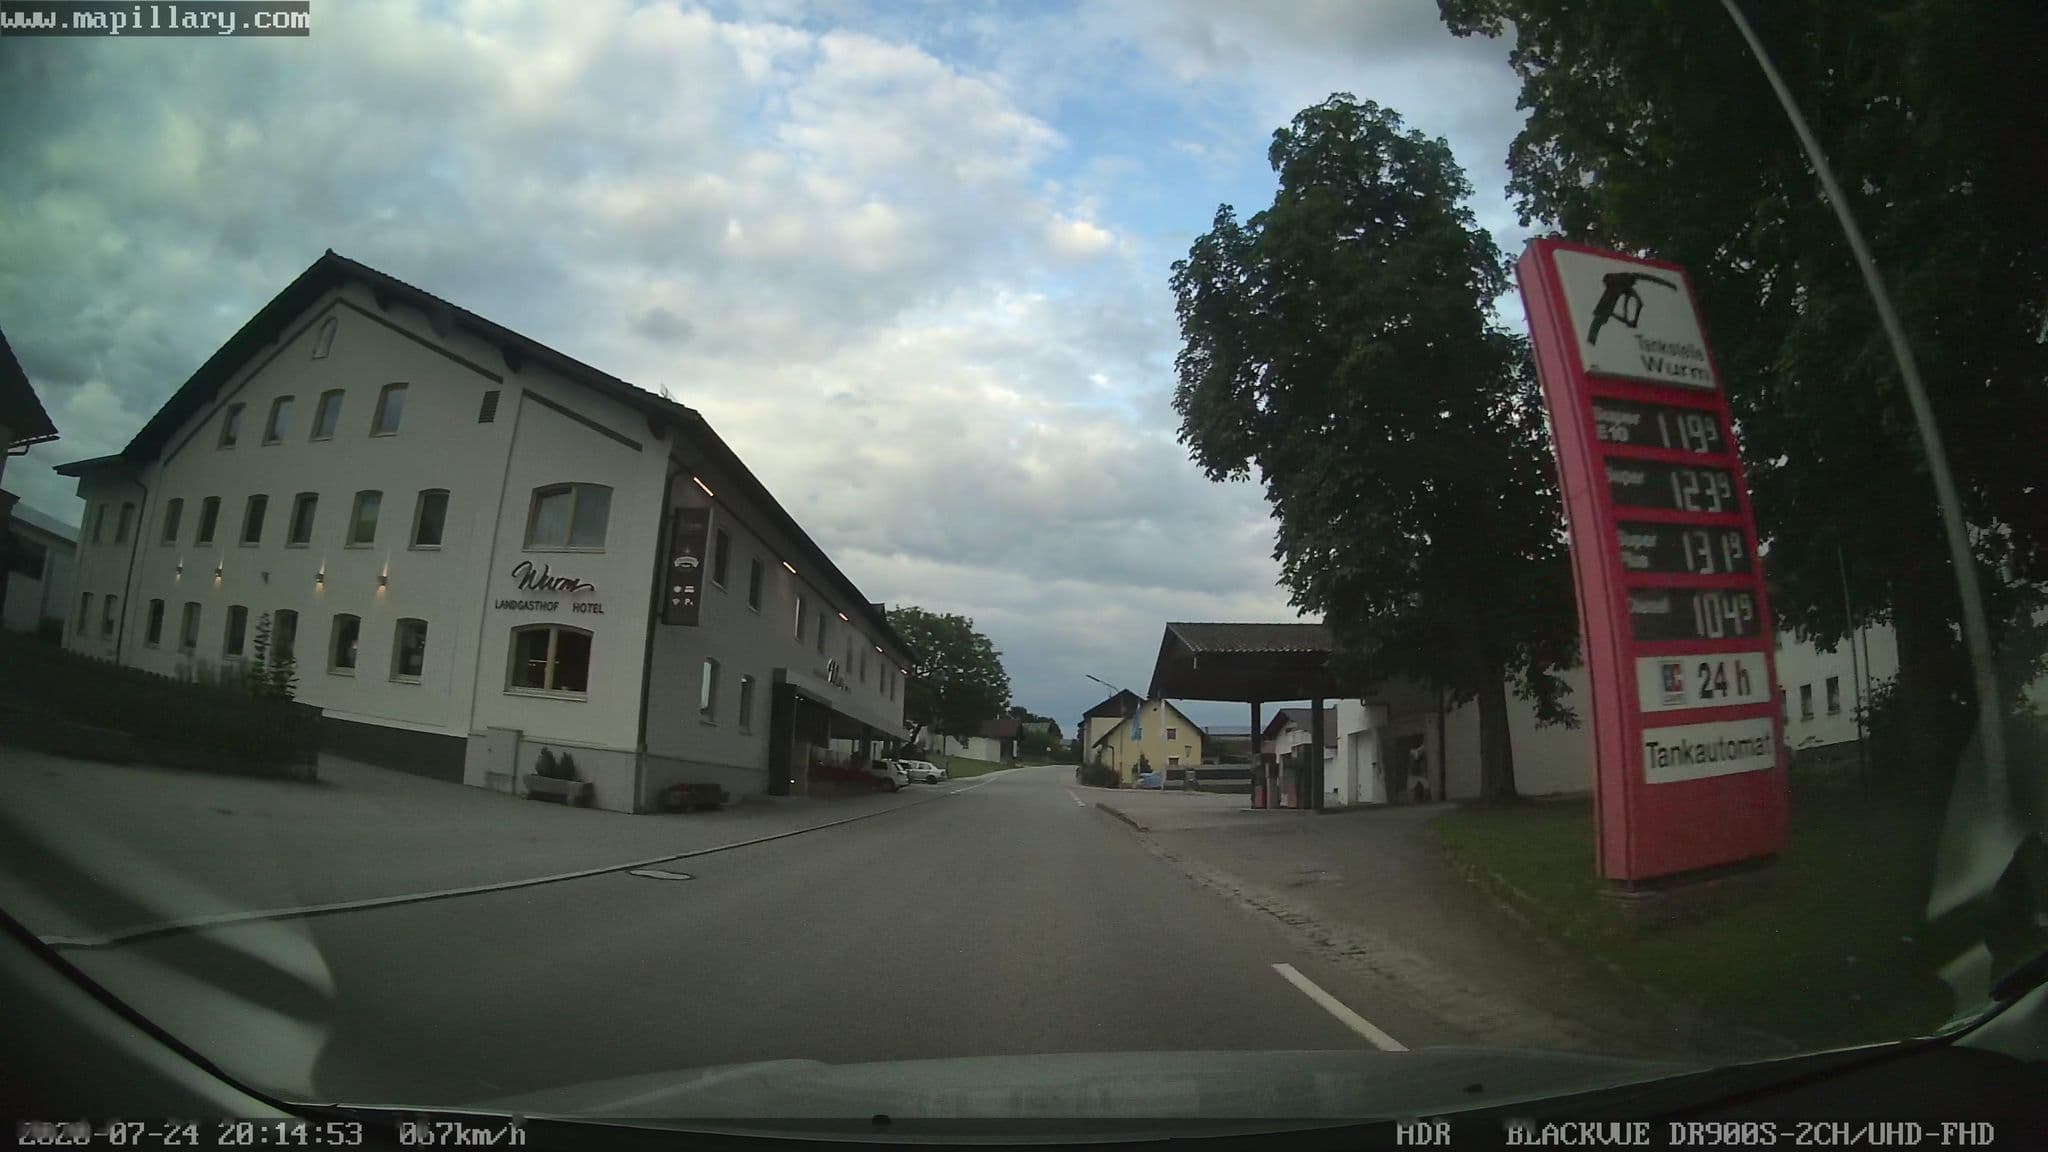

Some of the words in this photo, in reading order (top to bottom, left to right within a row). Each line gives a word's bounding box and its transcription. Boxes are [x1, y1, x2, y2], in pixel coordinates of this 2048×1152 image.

[1640, 354, 1711, 382] Wurm
[511, 560, 595, 593] Wurm
[495, 599, 560, 612] LANDGASTHOF
[572, 602, 605, 615] HOTEL
[1698, 661, 1728, 699] 24
[1735, 659, 1751, 697] h
[1645, 733, 1772, 769] Tankautomat
